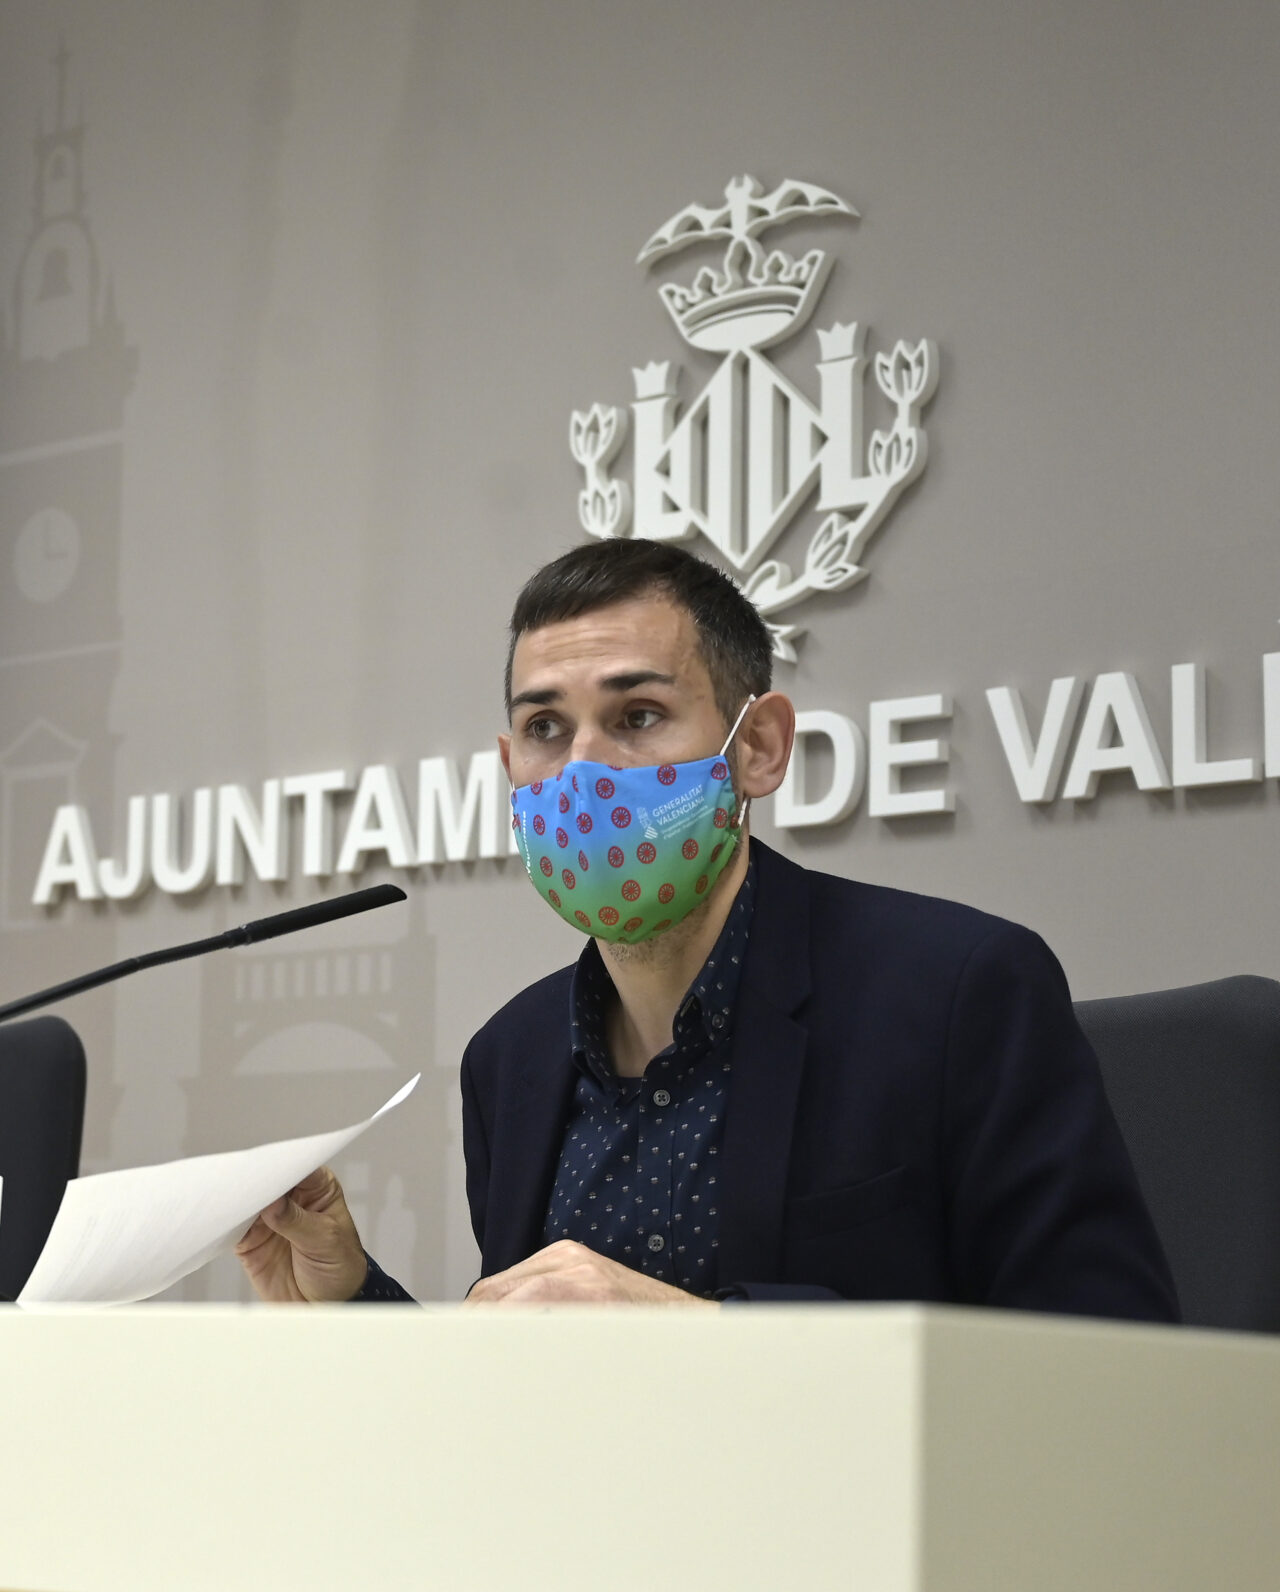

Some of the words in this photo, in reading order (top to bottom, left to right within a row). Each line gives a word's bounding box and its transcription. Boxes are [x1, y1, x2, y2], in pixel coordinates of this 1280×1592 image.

[33, 750, 521, 905] AJUNTAM
[775, 694, 955, 829] DE
[986, 650, 1280, 803] VAL
[652, 784, 703, 817] GENERALITAT
[656, 796, 705, 826] VALENCIANA
